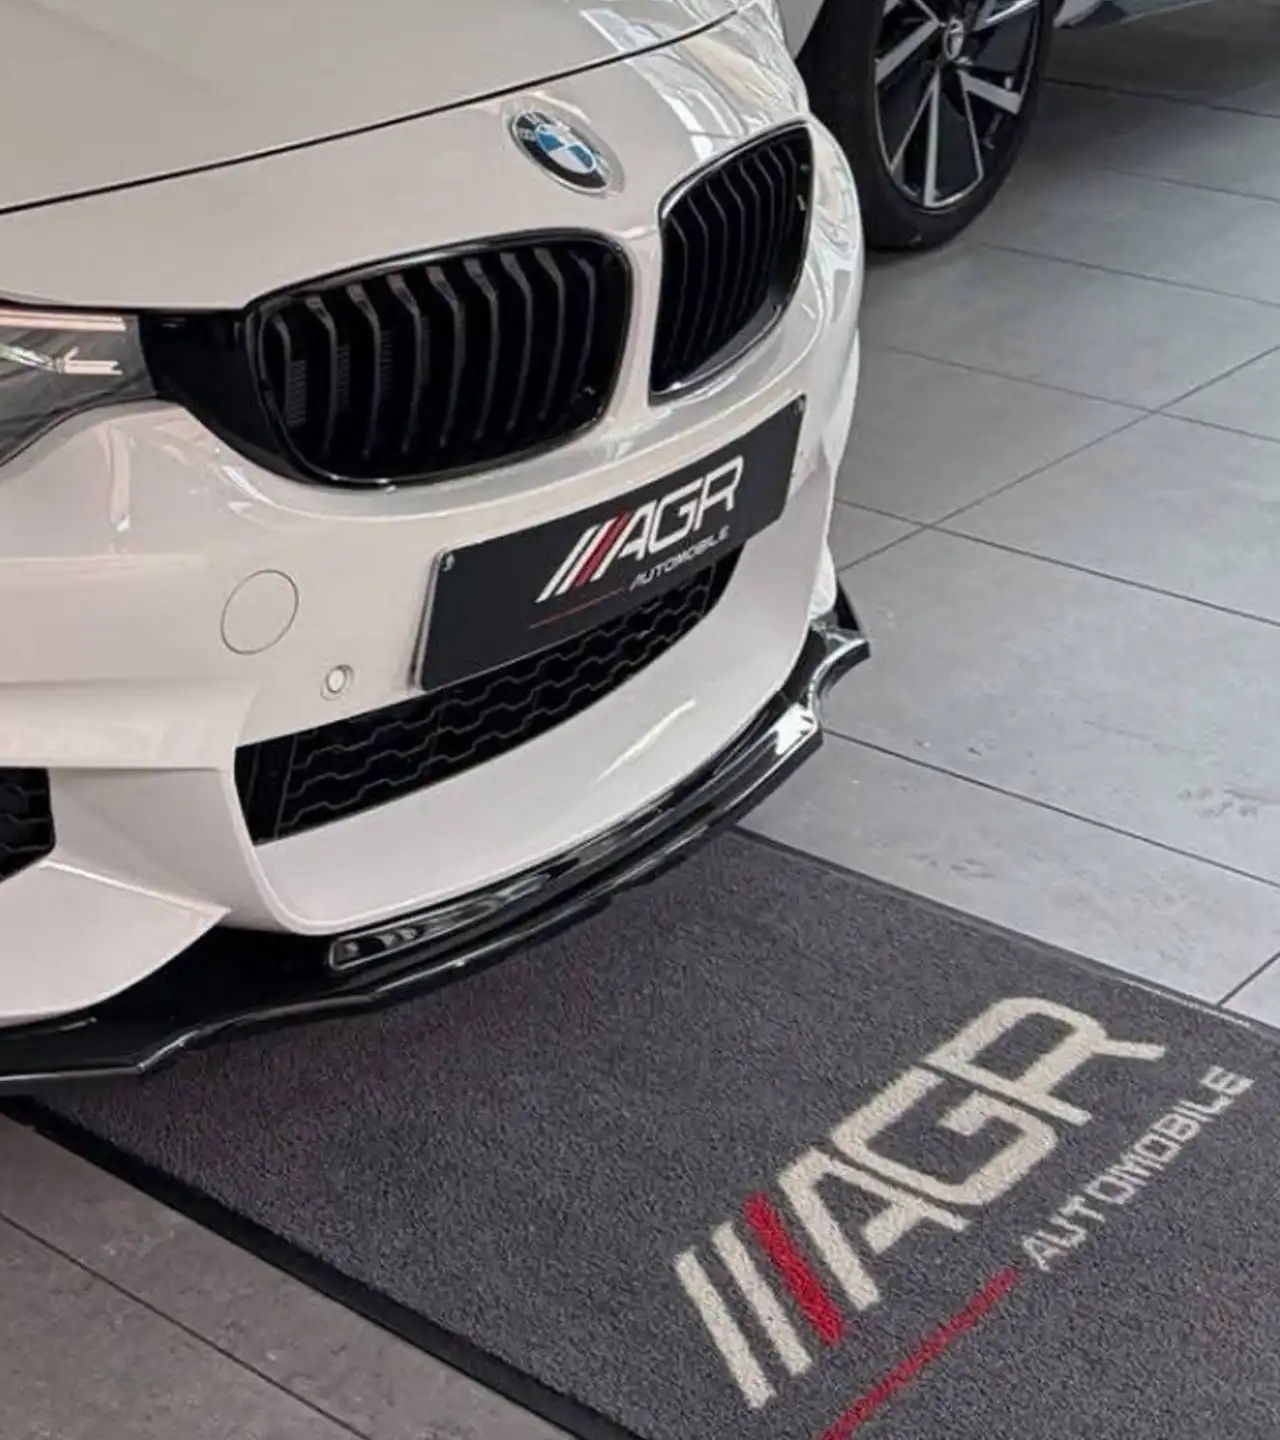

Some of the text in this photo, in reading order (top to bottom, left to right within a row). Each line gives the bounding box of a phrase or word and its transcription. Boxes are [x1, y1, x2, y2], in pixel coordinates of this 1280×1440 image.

[591, 455, 744, 580] AGR
[630, 524, 731, 592] AUTOMOBILE
[777, 996, 1165, 1311] AGR
[1020, 1063, 1254, 1272] AUTOMOBILE
